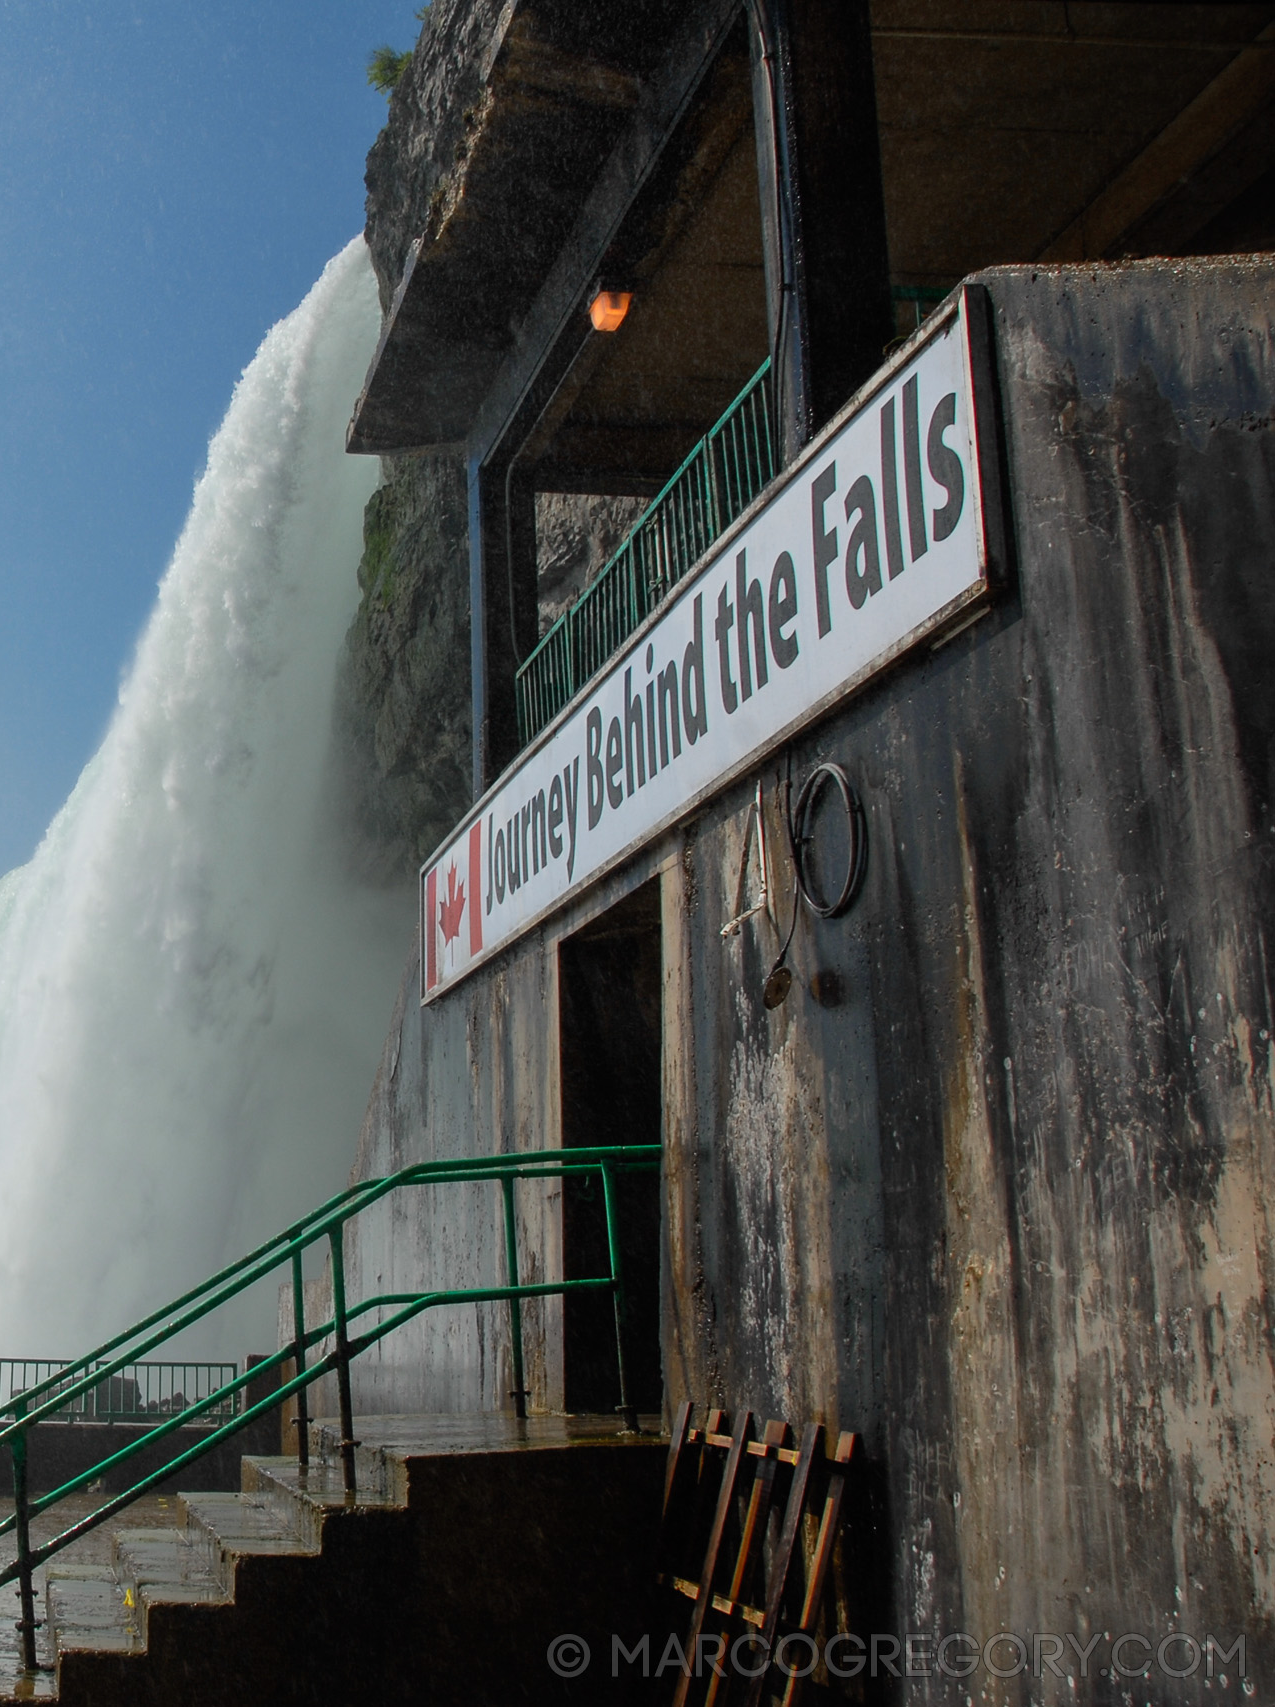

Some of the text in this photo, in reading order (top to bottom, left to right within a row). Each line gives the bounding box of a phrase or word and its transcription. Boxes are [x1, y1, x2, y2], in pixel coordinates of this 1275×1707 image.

[486, 372, 965, 916] Journey Behind the Falls
